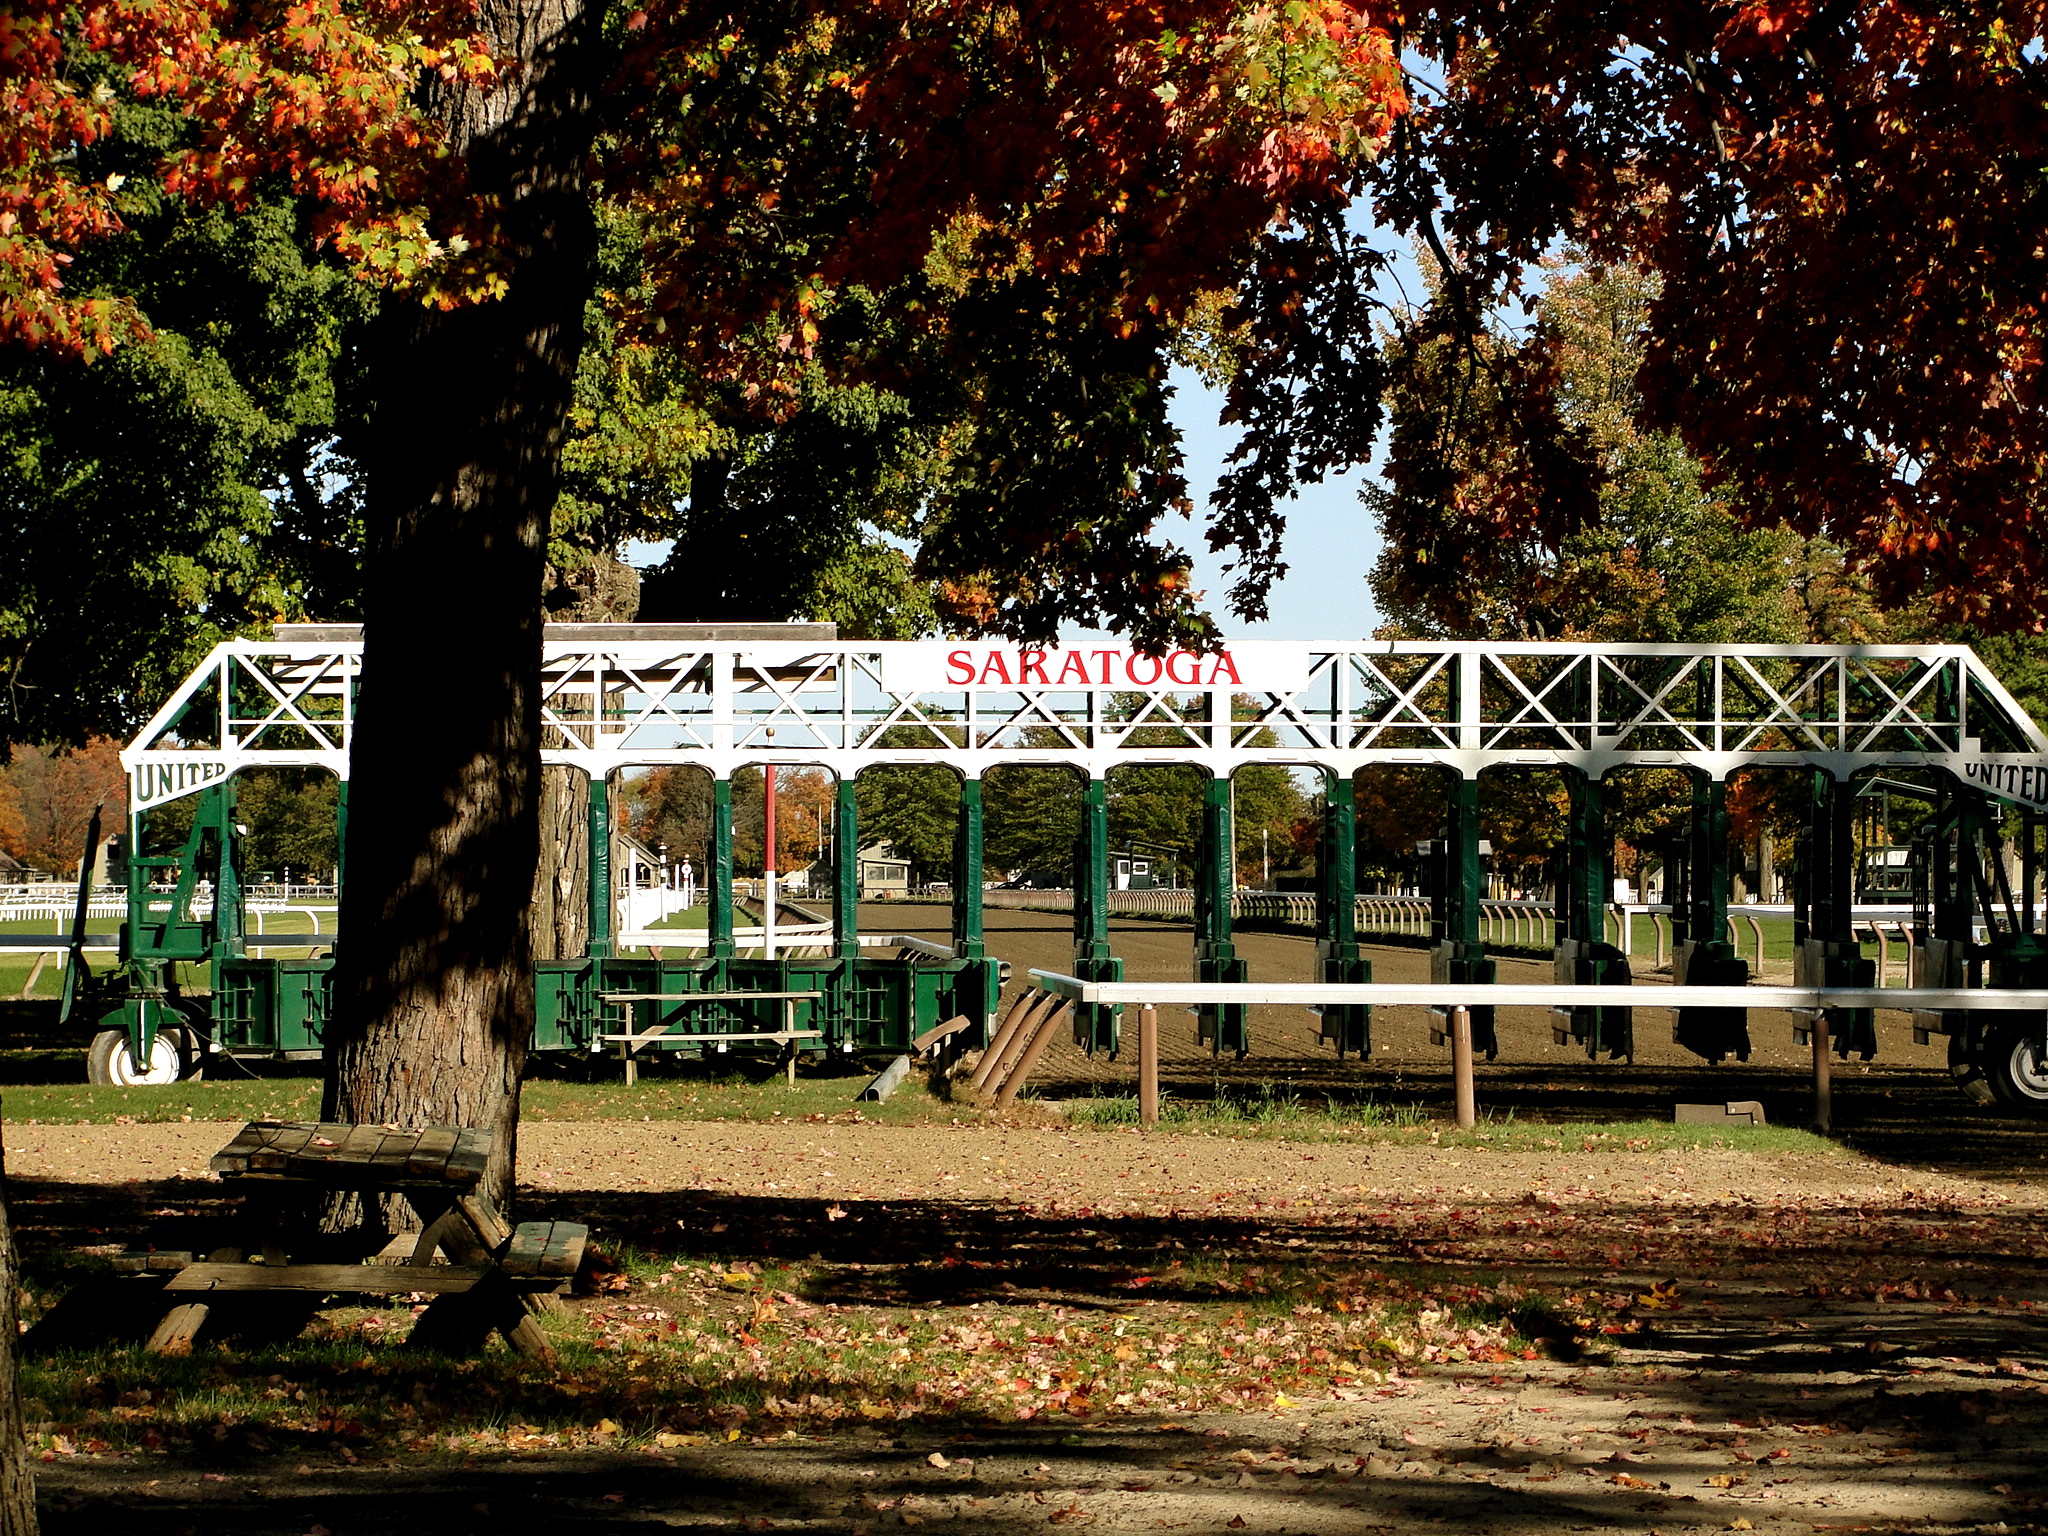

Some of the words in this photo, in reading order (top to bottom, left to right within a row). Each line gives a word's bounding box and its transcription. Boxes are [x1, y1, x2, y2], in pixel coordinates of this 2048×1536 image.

[946, 650, 1244, 686] SARATOGA
[134, 762, 226, 802] UNITED
[1964, 762, 2048, 806] UNITED
